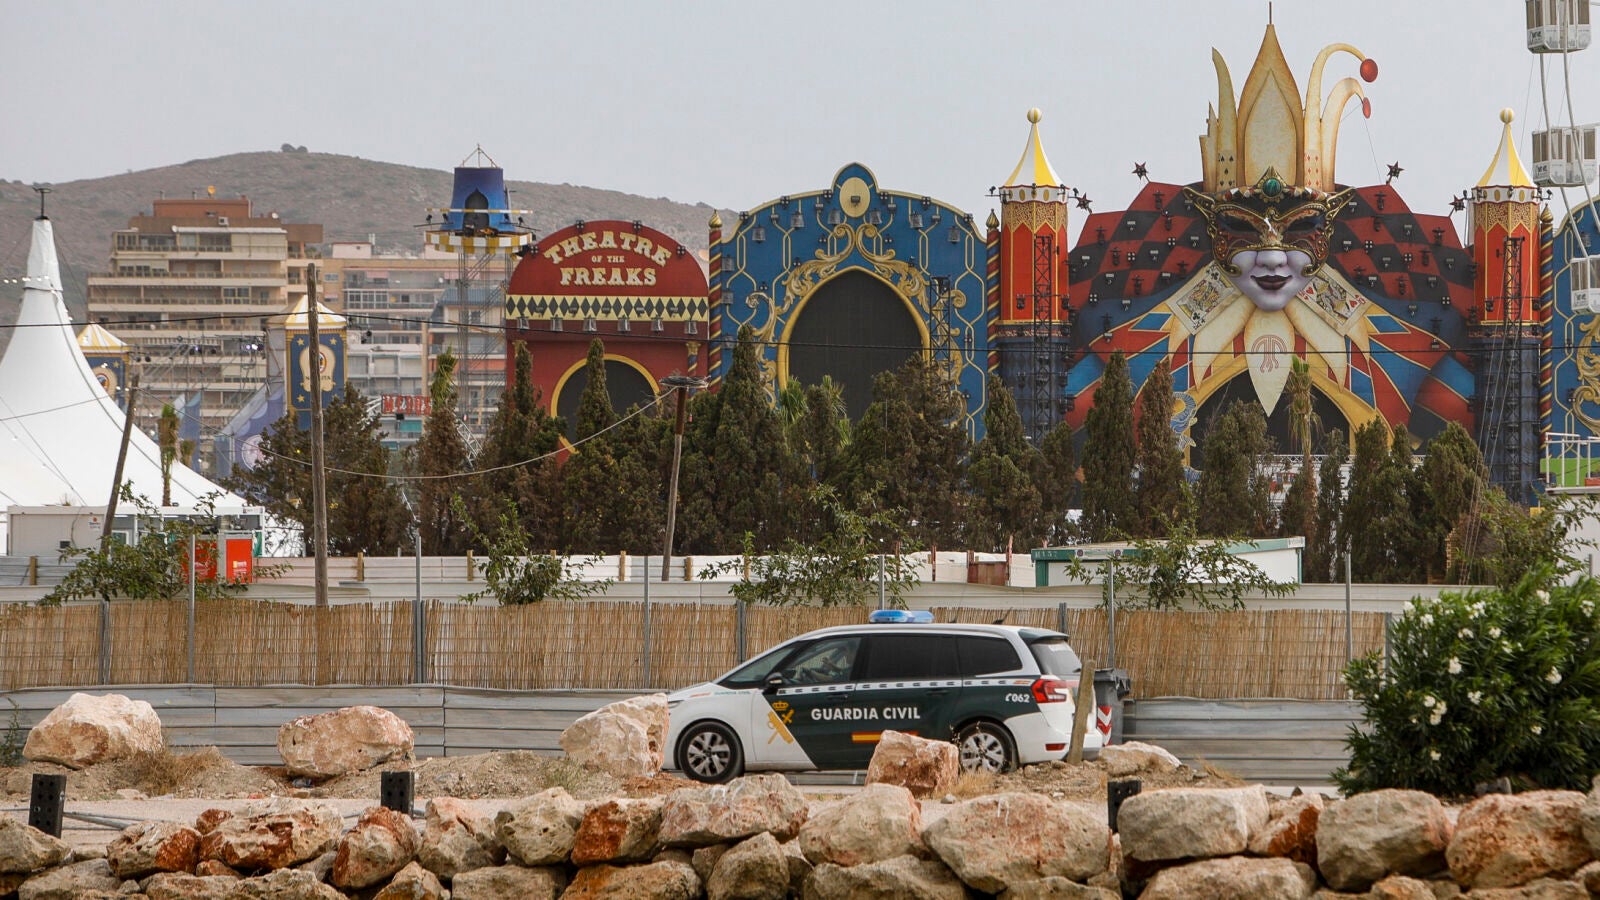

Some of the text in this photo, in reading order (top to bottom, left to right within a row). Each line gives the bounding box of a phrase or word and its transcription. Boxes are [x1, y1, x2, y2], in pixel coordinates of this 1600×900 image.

[543, 231, 672, 267] THEATRE
[591, 255, 625, 263] OF THE
[560, 267, 657, 286] FREAKS
[811, 707, 920, 720] GUARDIA CIVIL
